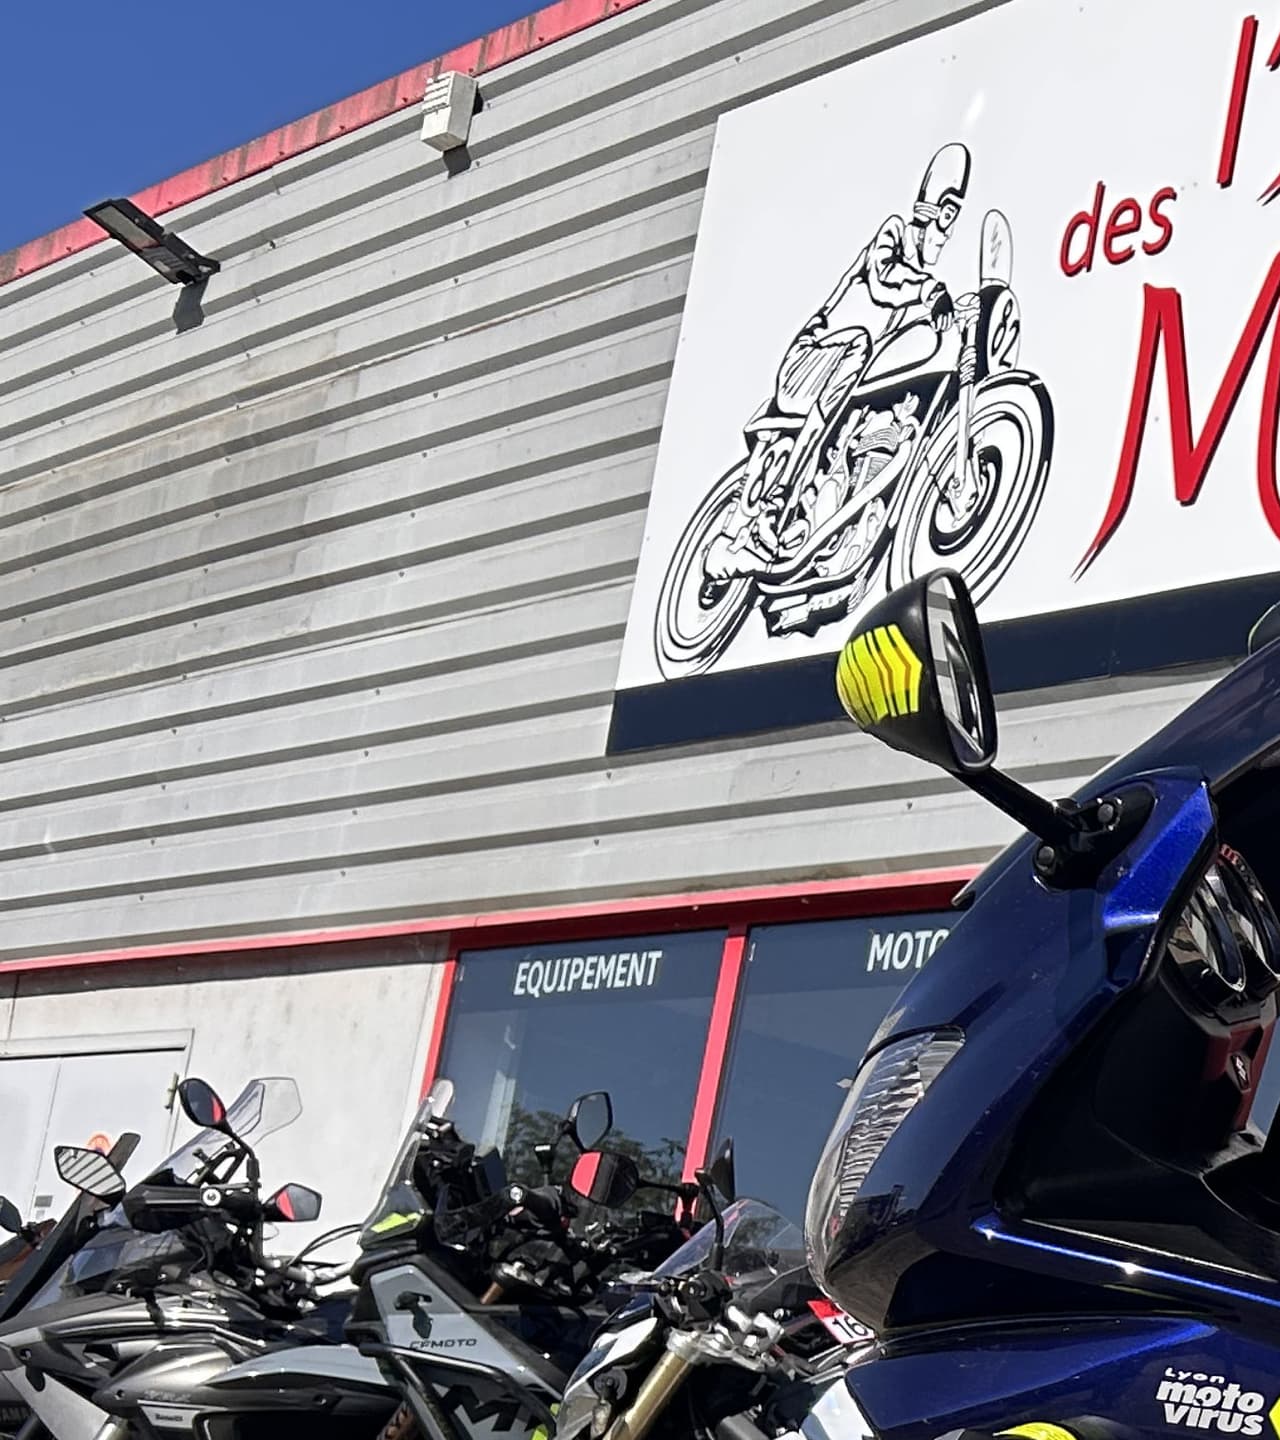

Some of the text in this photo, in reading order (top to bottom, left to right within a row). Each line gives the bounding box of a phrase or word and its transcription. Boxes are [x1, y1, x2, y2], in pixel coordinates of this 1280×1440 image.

[1059, 181, 1177, 277] des
[990, 297, 1021, 369] 82
[513, 950, 663, 998] EQUIPEMENT
[1164, 1367, 1225, 1384] Lyon
[1155, 1380, 1265, 1414] moto
[1163, 1402, 1265, 1436] virus
